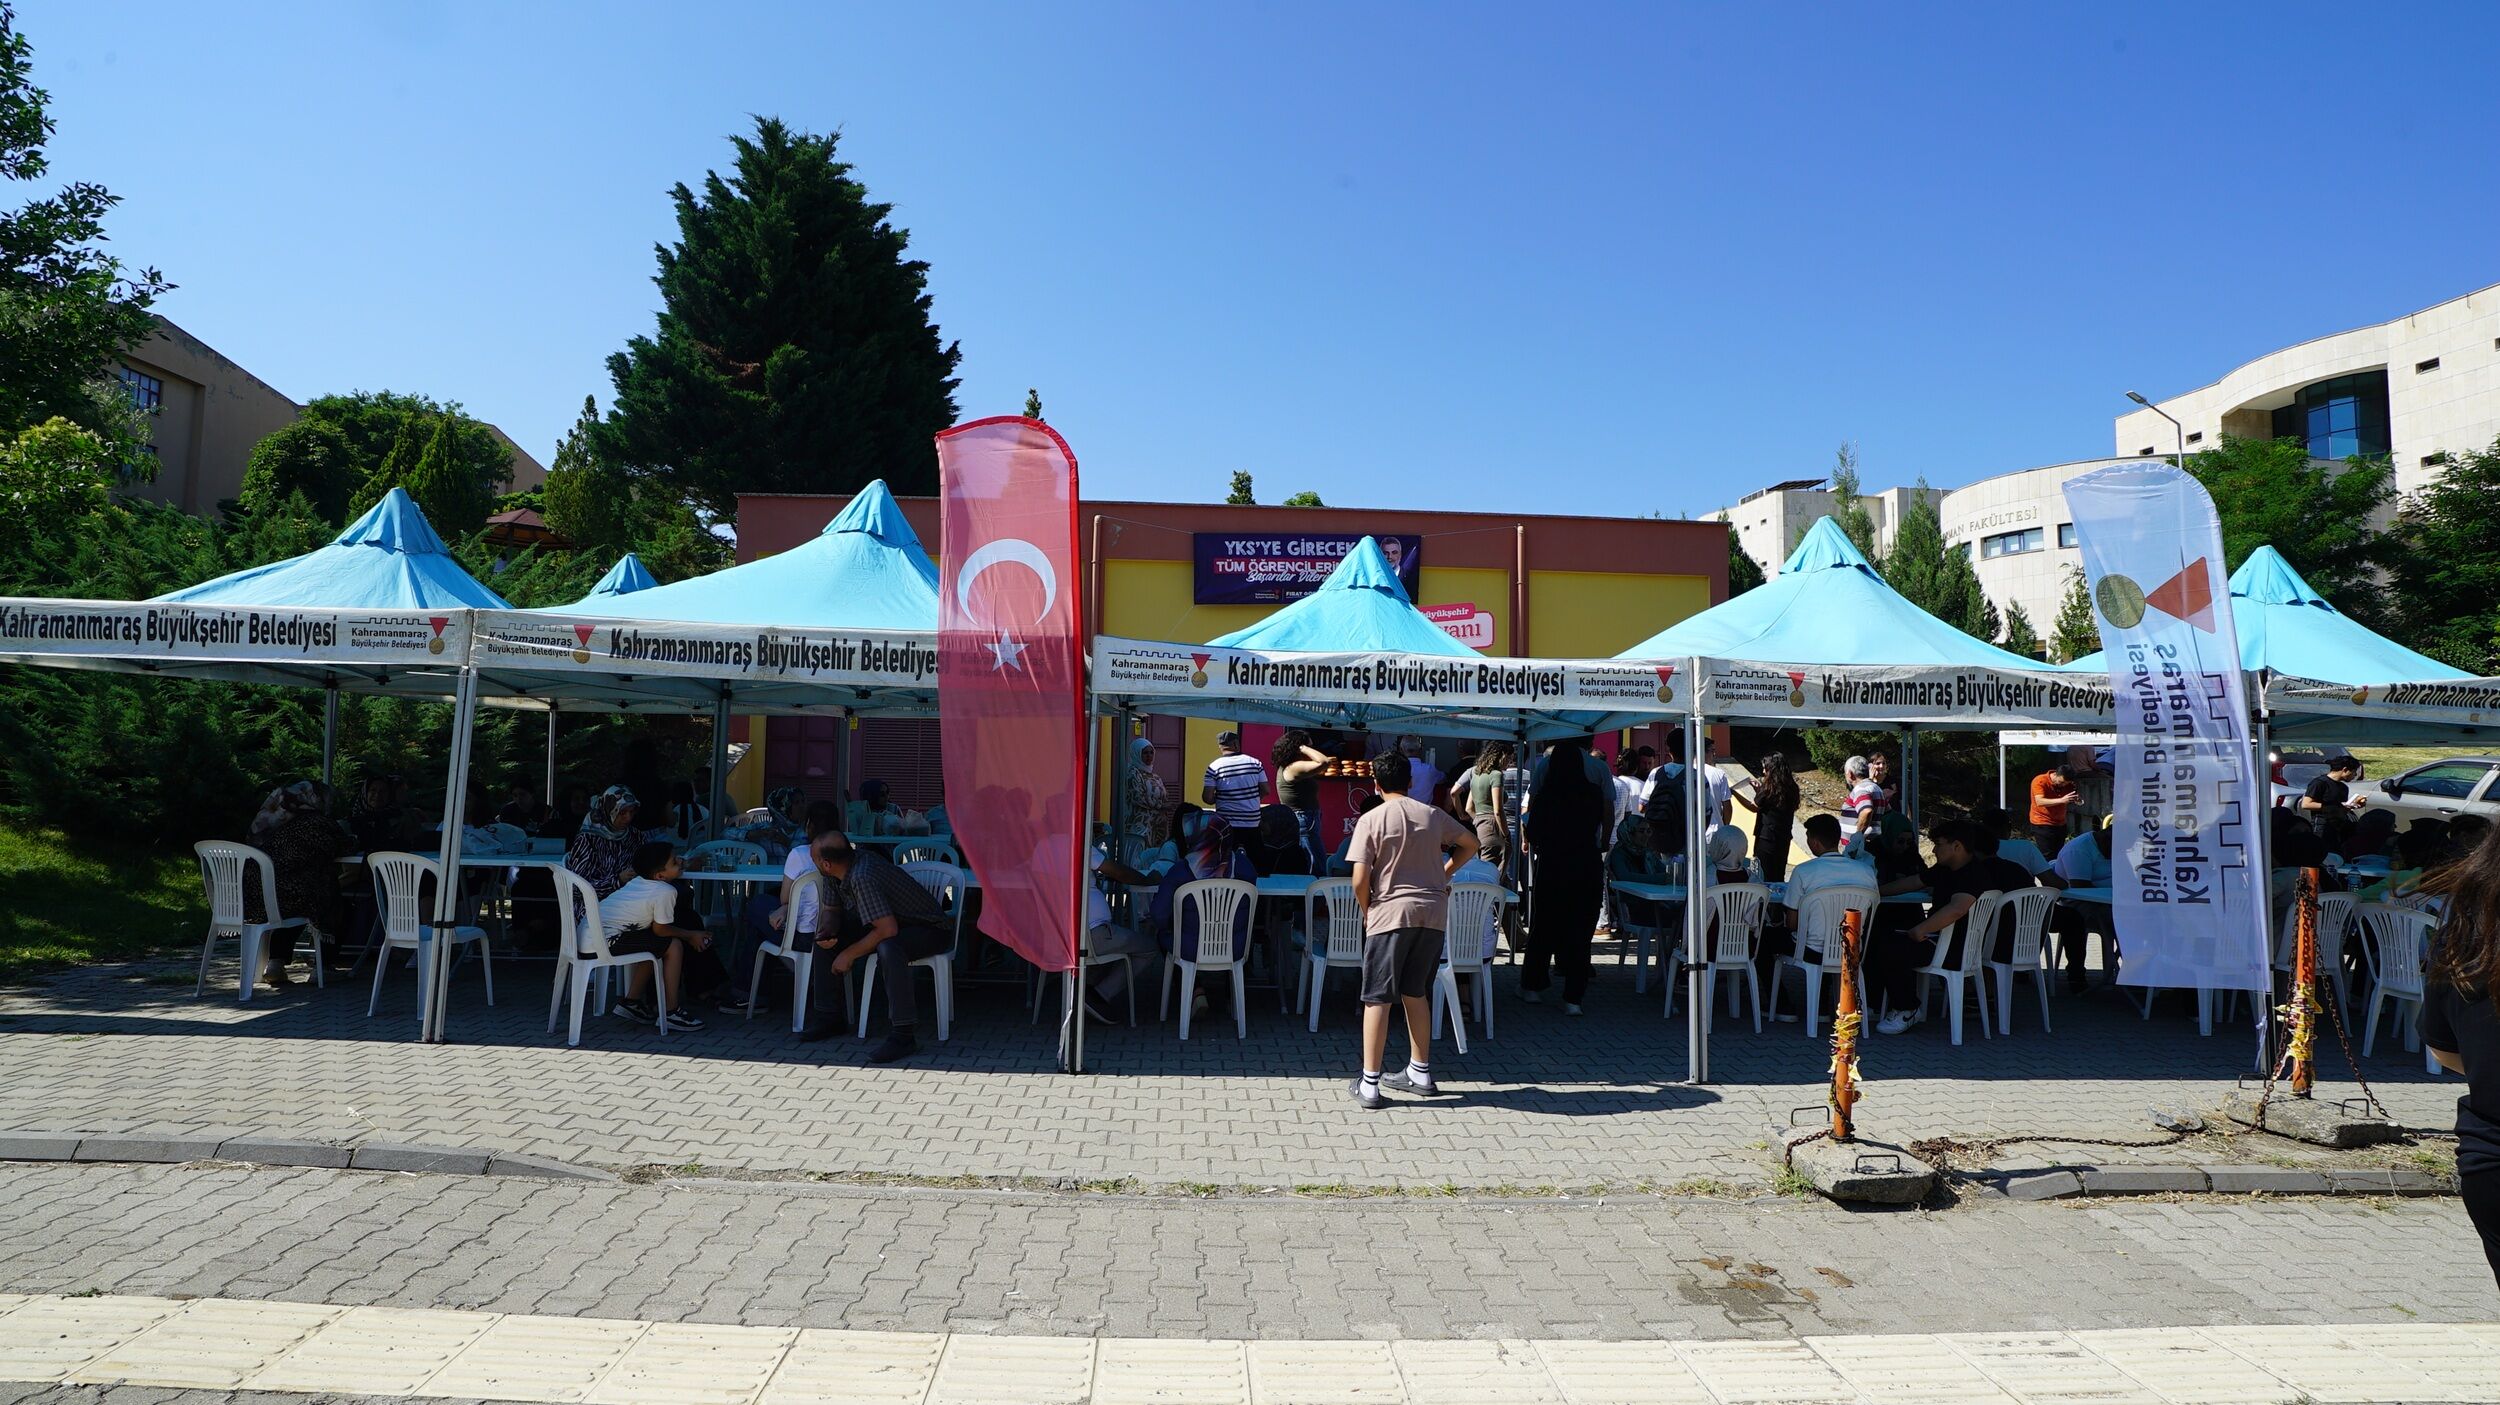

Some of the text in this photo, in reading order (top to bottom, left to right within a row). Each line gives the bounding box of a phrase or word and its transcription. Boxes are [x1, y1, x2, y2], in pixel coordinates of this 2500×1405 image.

[1969, 505, 2038, 532] FAKÜLTESİ
[1224, 540, 1281, 556] YKS'YE
[1216, 559, 1245, 572] TÜM
[1423, 607, 1470, 620] üyükşehir
[0, 606, 338, 653] Kahramanmaraş Büyükşehir Belediyesi
[351, 627, 428, 640] Kahramanmaraş
[351, 638, 427, 650] Büyükşehir Belediyesi
[487, 643, 530, 656] Büyükşehir
[609, 628, 752, 673] Kahramanmaraş
[757, 634, 856, 676] Büyükşehir
[1111, 658, 1190, 674] Kahramanmaraş
[1111, 669, 1189, 683] Büyükşehir Belediyesi
[1227, 655, 1565, 702] Kahramanmaraş Büyükşehir Belediyesi
[1579, 677, 1655, 688] Kahramanmaraş
[1715, 679, 1787, 692] Kahramanmaraş
[1579, 688, 1655, 699] Büyükşehir Belediyesi
[1715, 691, 1788, 703] Büyükşehir Belediyesi
[1822, 673, 1953, 710] Kahramanmaraş
[1957, 674, 2047, 713] Büyükşehir
